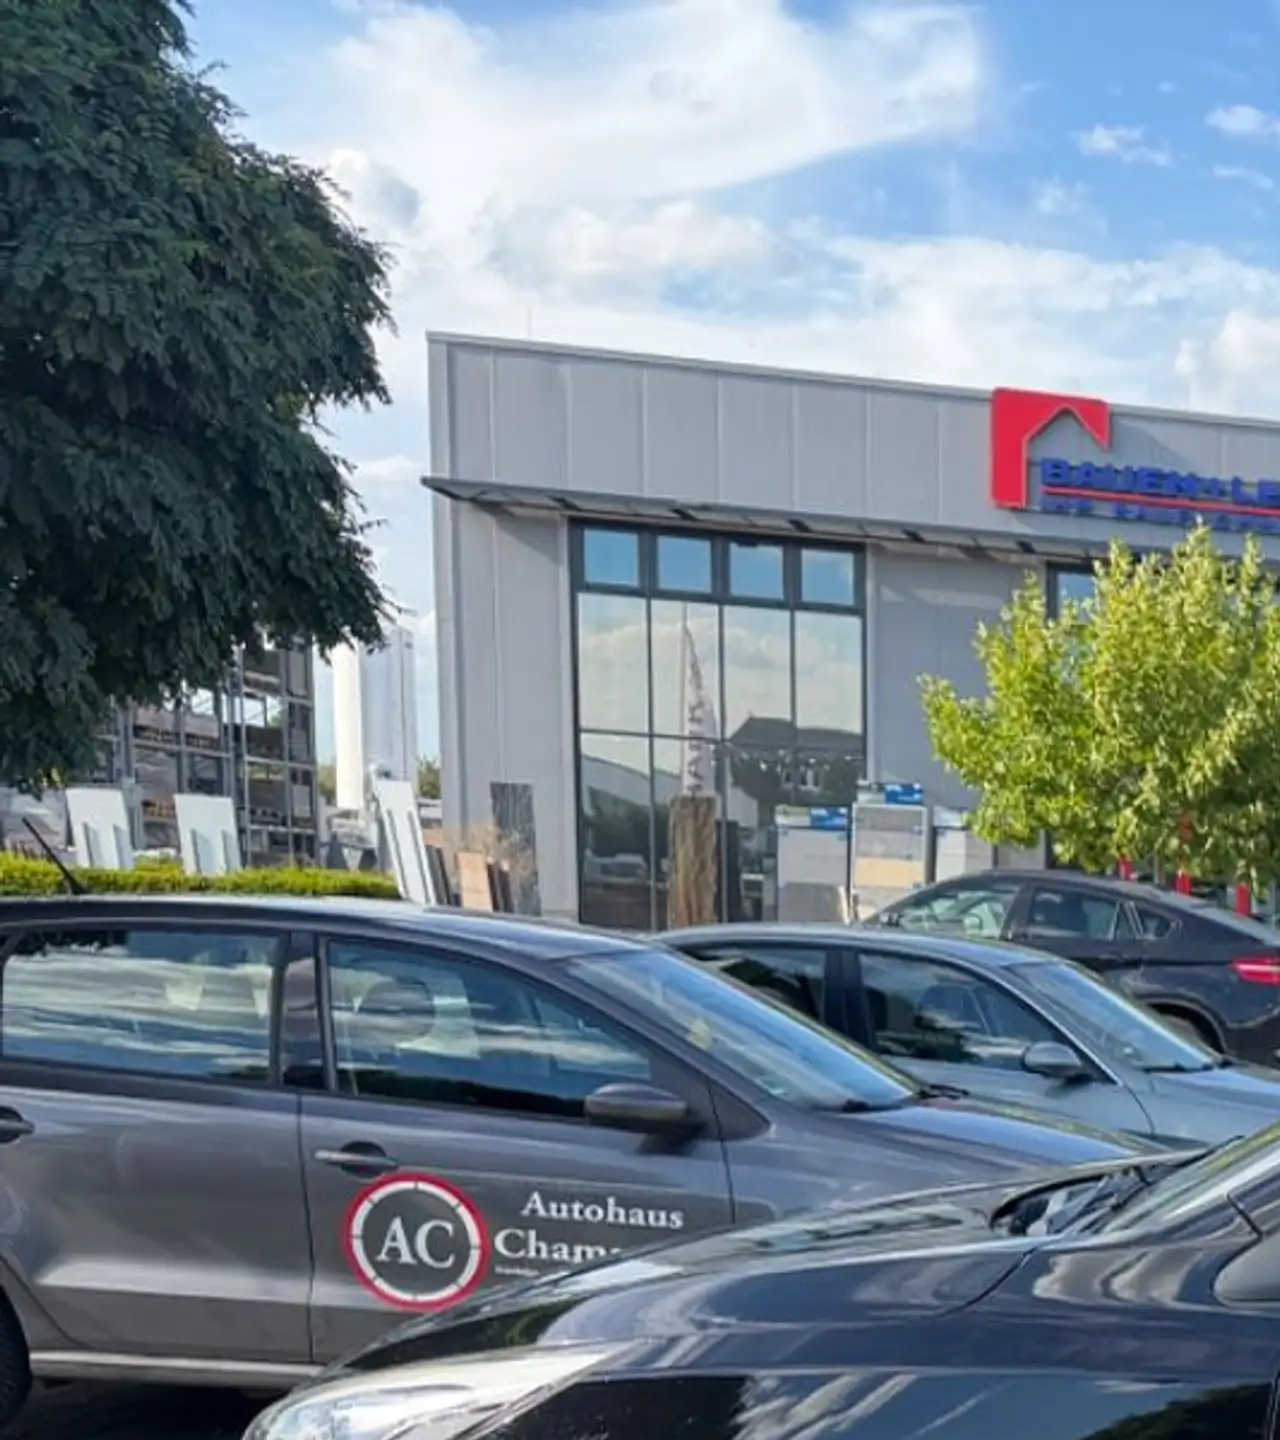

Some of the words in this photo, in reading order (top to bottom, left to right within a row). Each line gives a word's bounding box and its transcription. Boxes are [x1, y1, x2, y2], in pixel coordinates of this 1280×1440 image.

[520, 1190, 684, 1230] Autohaus
[376, 1216, 455, 1269] AC
[494, 1228, 621, 1263] Cham
